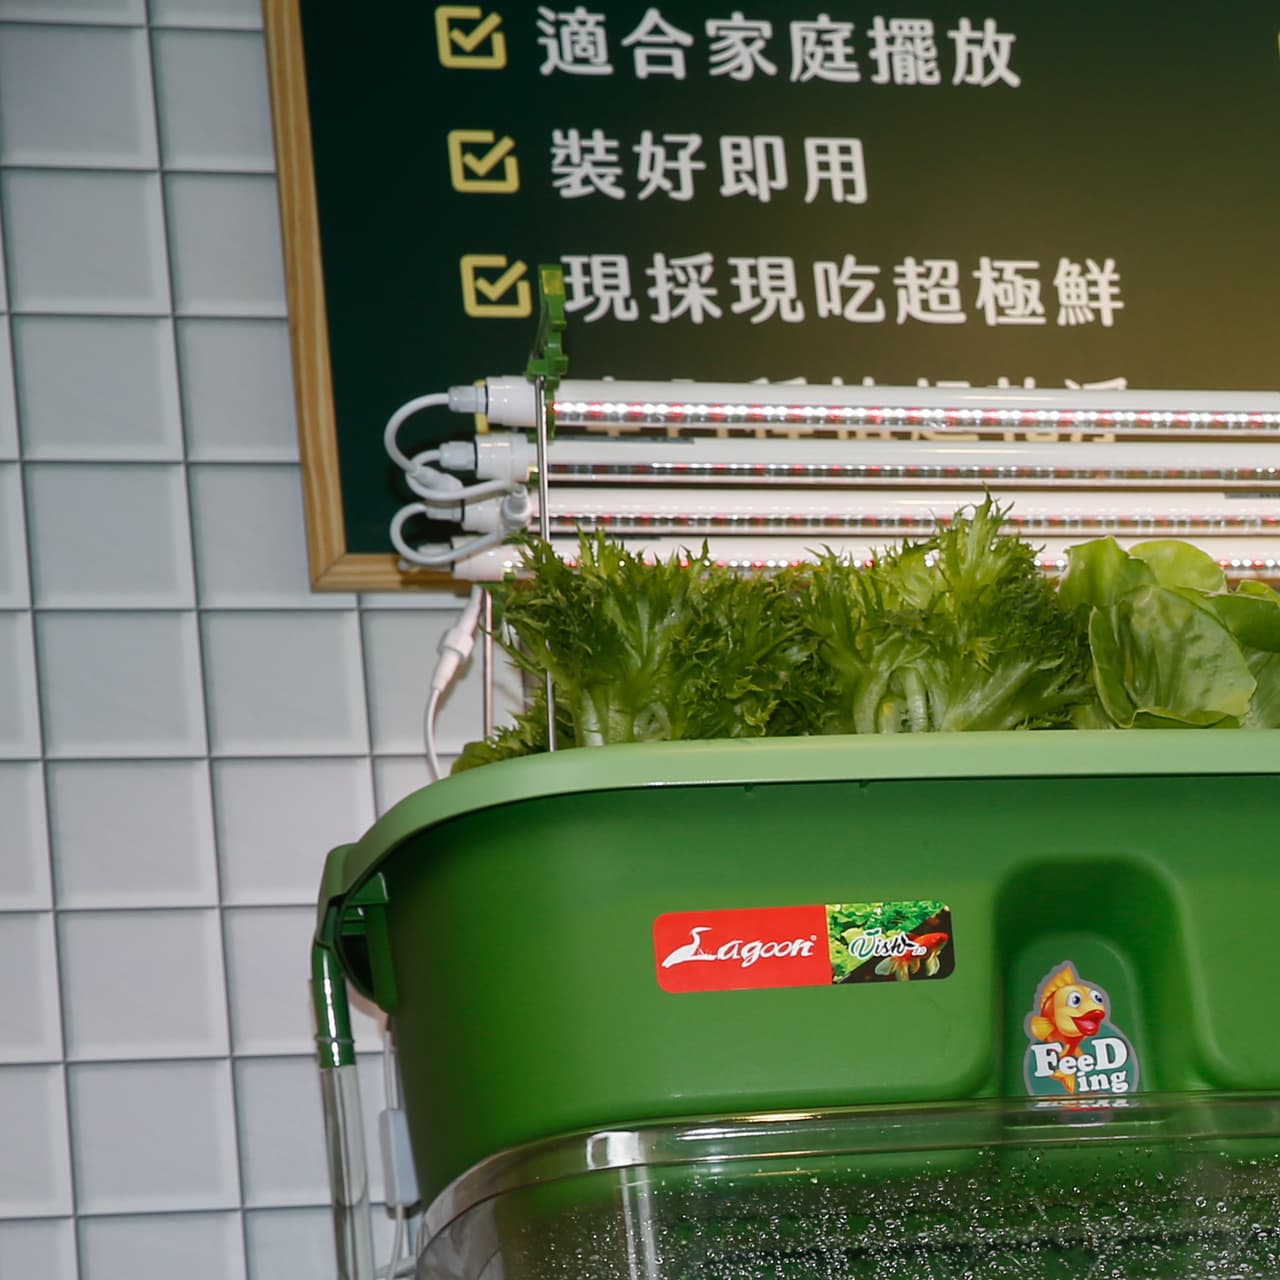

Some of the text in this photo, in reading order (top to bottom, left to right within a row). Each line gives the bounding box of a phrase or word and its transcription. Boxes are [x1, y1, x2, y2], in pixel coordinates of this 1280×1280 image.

[537, 6, 1021, 88] 適合家庭擺放
[550, 128, 869, 204] 裝好即用
[561, 253, 1125, 327] 現採現吃超極鮮
[661, 926, 815, 968] Lagoon
[1077, 1070, 1129, 1093] ing
